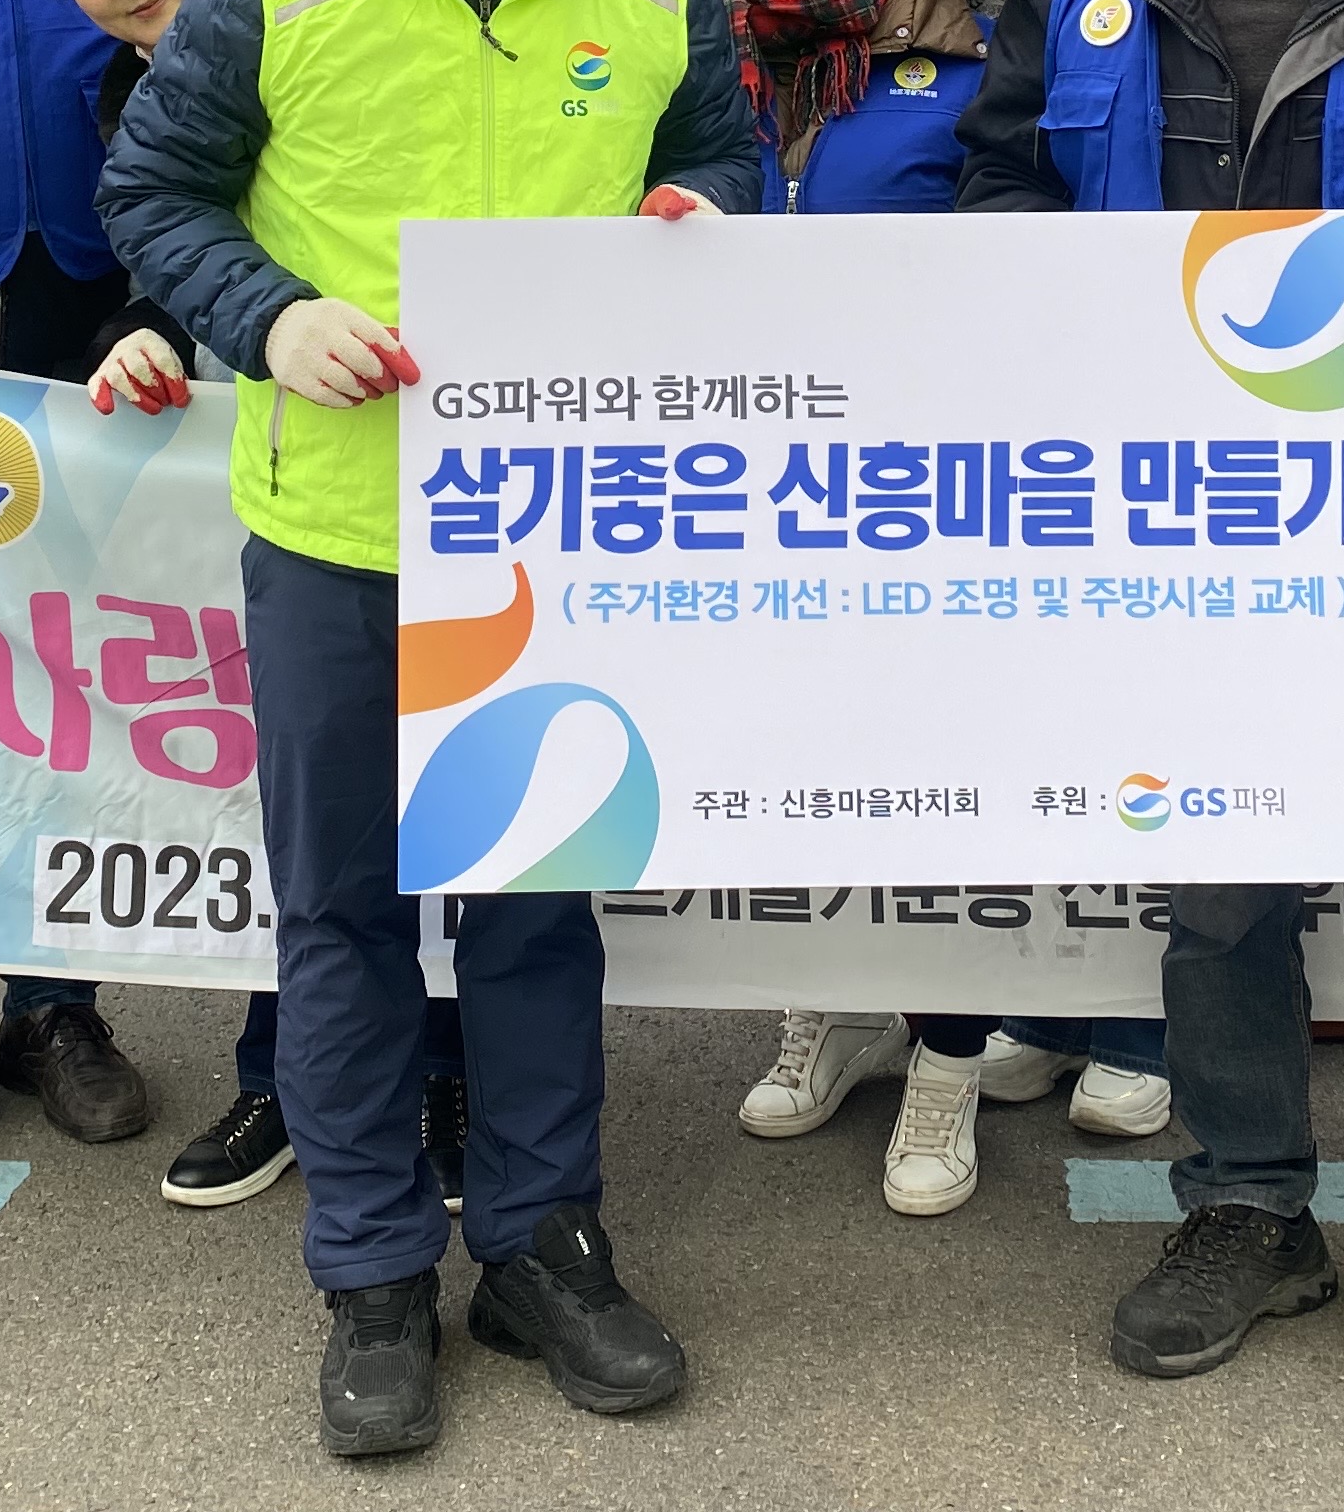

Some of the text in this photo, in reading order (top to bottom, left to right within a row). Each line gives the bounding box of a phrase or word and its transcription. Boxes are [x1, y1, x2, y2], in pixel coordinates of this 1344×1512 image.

[561, 99, 588, 117] GS
[432, 373, 849, 422] GS파워와 함께하는
[420, 442, 748, 554] 살기좋은
[767, 439, 1095, 551] 신흥마을
[586, 579, 739, 623] 주거환경
[752, 577, 828, 620] 개선
[863, 582, 932, 615] LED
[943, 577, 1019, 619] 조명
[1033, 577, 1070, 618] 및
[1081, 576, 1235, 618] 주방시설
[1248, 576, 1325, 618] 교체
[692, 790, 750, 820] 주관
[779, 787, 980, 820] 신흥마을자치회
[1031, 785, 1088, 817] 후원
[46, 840, 272, 933] 2023.
